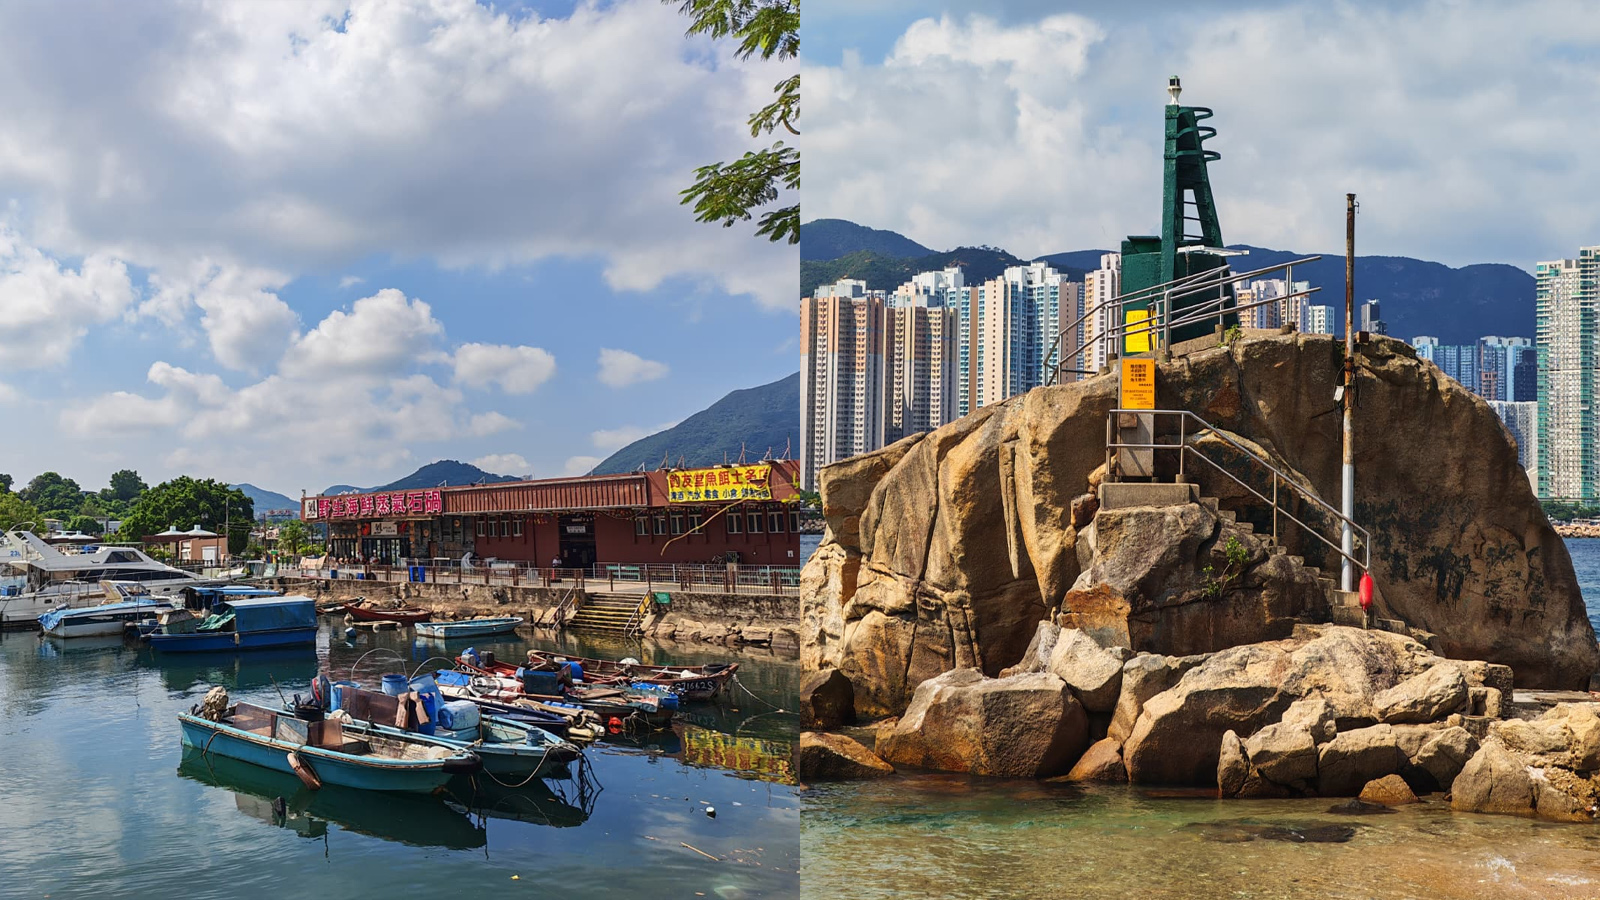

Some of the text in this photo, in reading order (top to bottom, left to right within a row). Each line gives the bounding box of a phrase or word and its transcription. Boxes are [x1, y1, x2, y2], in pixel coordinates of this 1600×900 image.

[318, 490, 442, 517] 野生海鮮蒸氣石鍋
